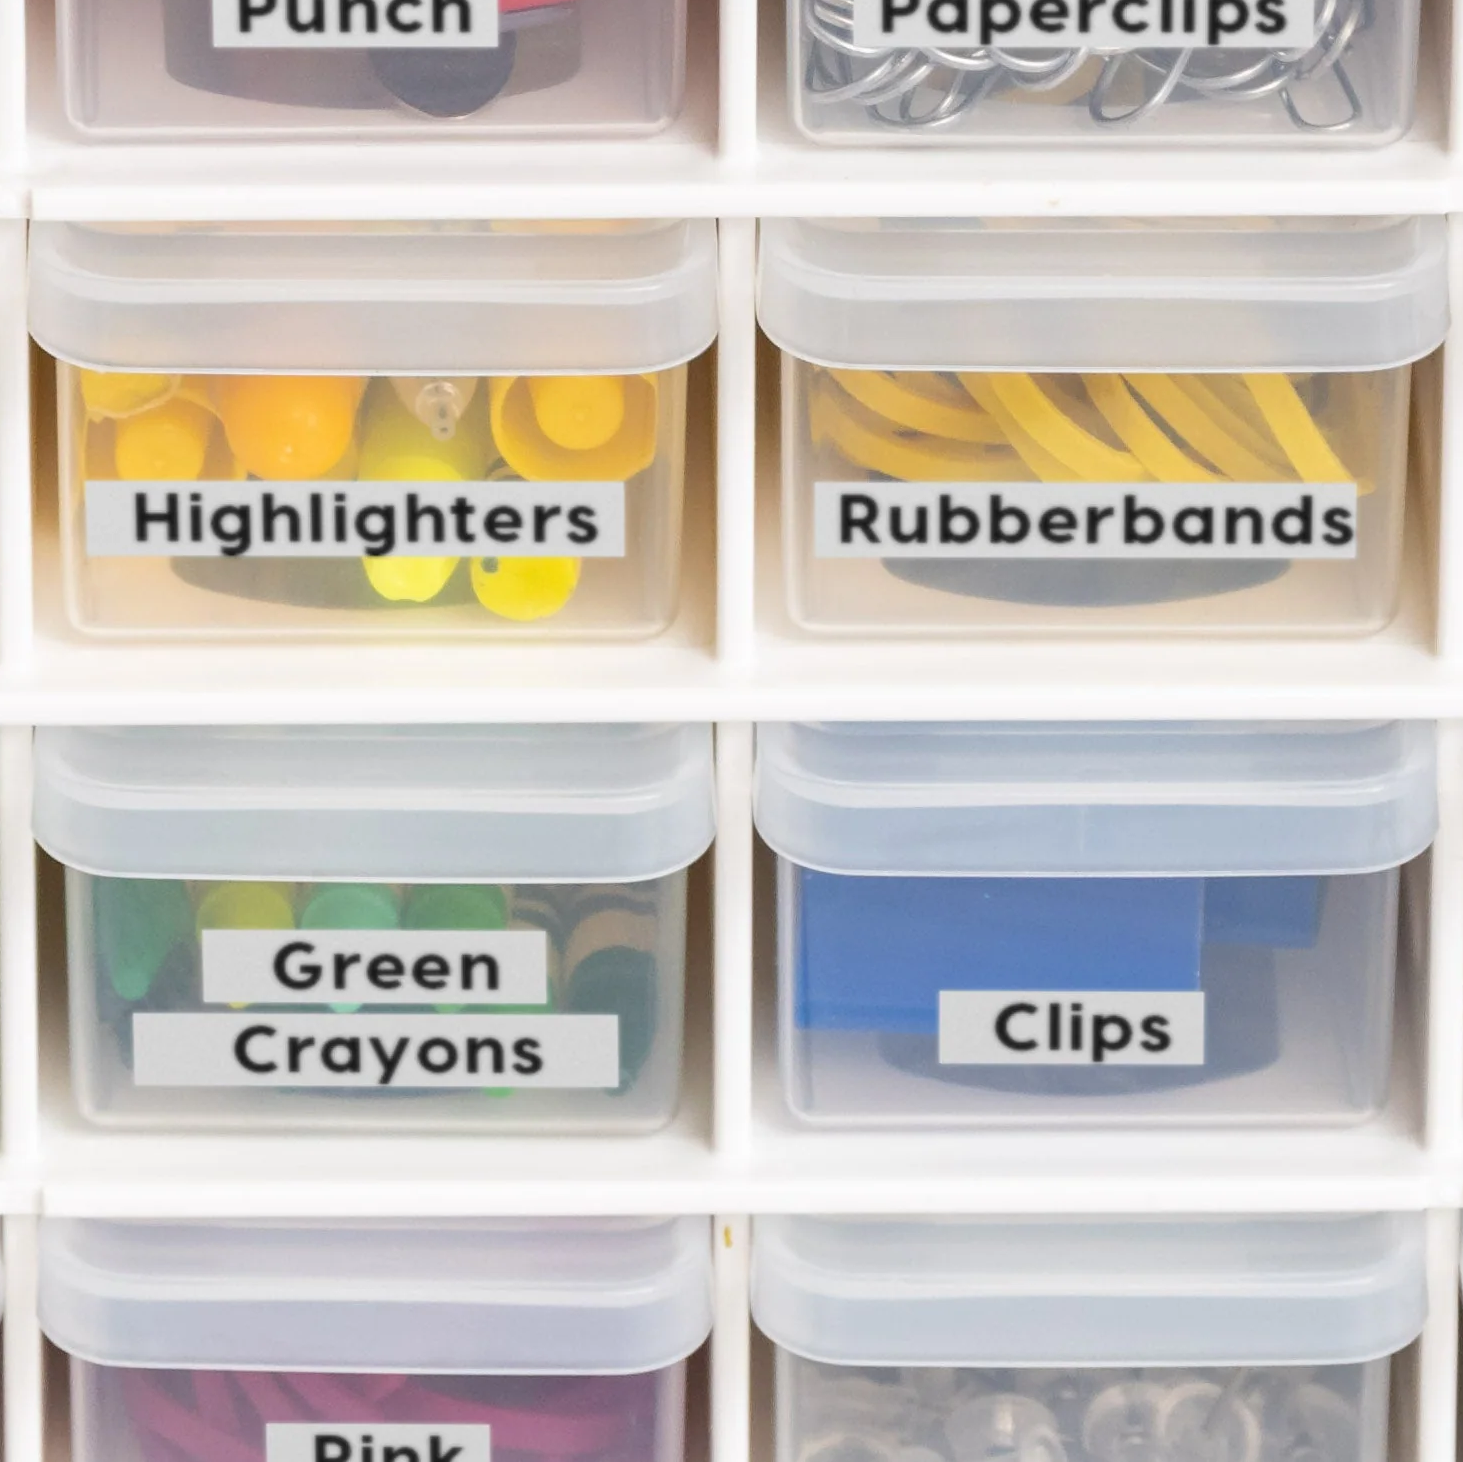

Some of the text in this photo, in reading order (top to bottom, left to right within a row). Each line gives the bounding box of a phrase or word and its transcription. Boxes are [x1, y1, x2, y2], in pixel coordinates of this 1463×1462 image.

[133, 490, 600, 556] Highlighters
[838, 492, 1356, 548] Rubberbands
[271, 939, 501, 992] Green
[232, 1023, 545, 1088] Crayons
[992, 1000, 1173, 1065] Clips
